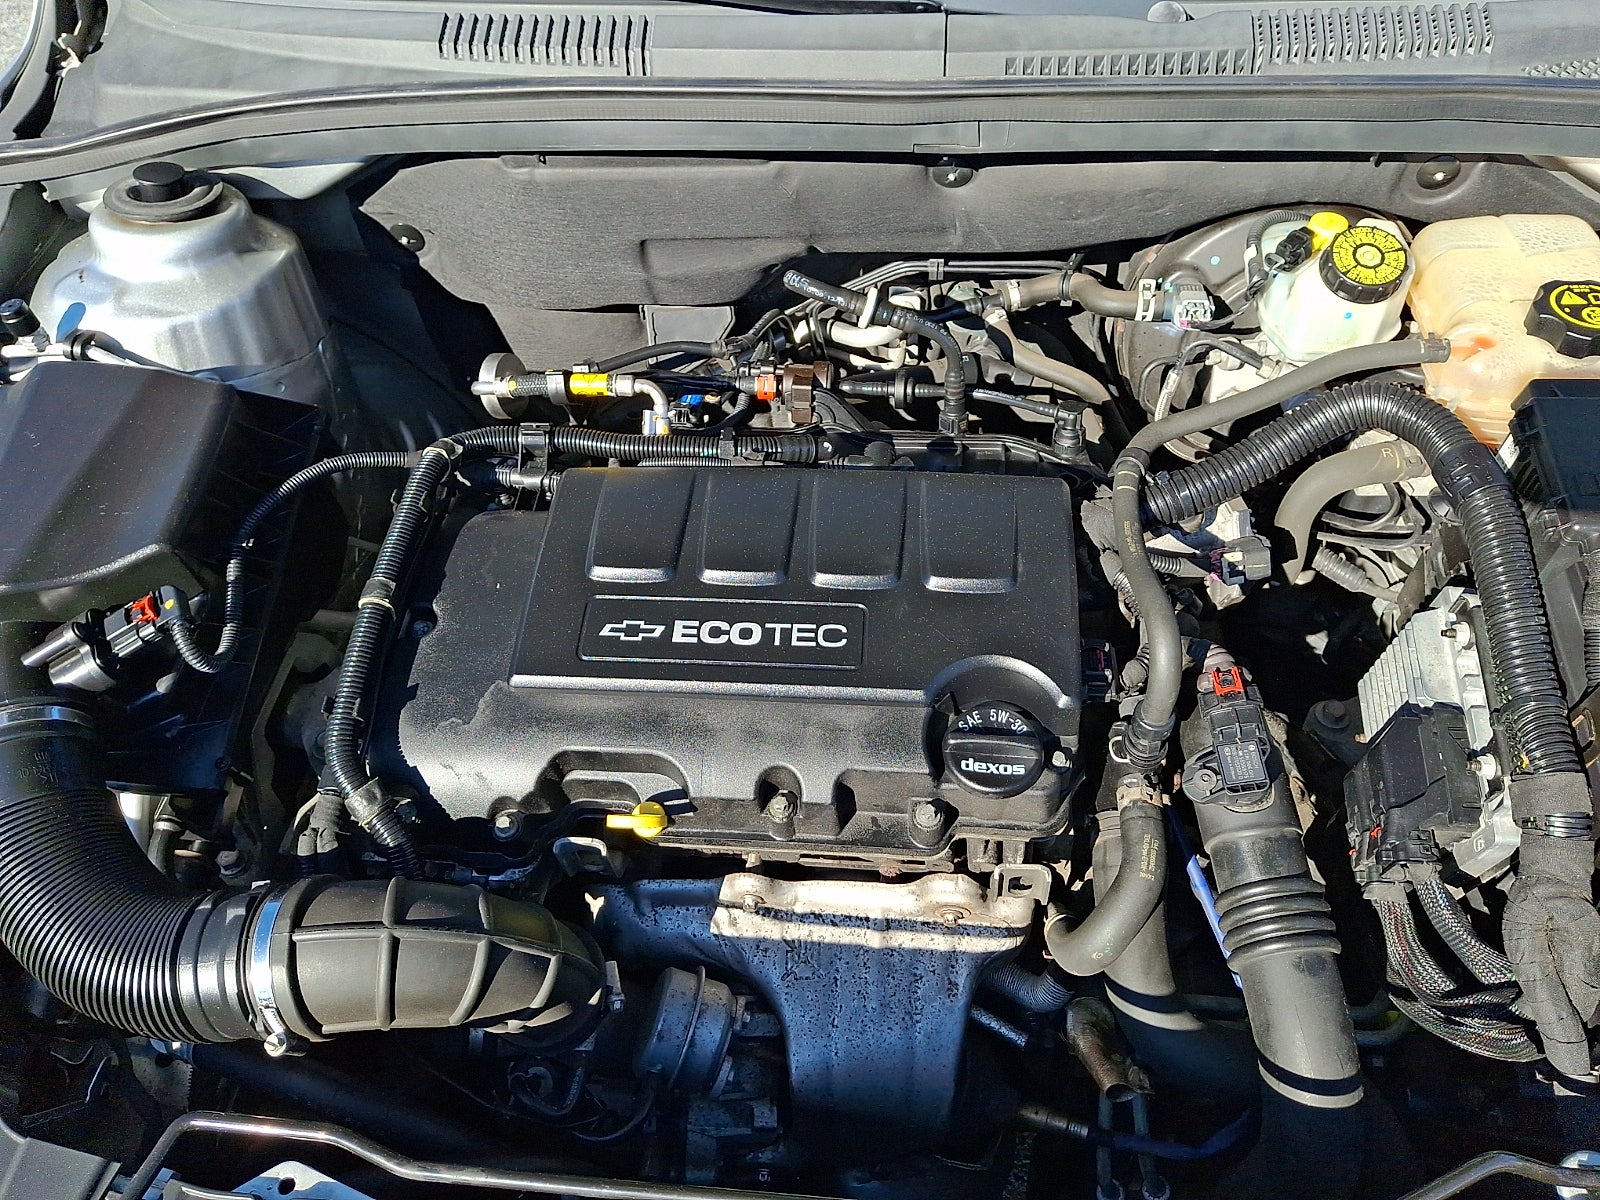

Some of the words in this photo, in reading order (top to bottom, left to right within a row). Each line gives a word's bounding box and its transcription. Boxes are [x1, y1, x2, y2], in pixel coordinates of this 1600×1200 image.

[1381, 447, 1394, 458] R
[671, 619, 848, 648] ECOTEC
[958, 710, 982, 731] SAE
[989, 708, 1028, 735] 5W-30
[960, 757, 1026, 775] dexos
